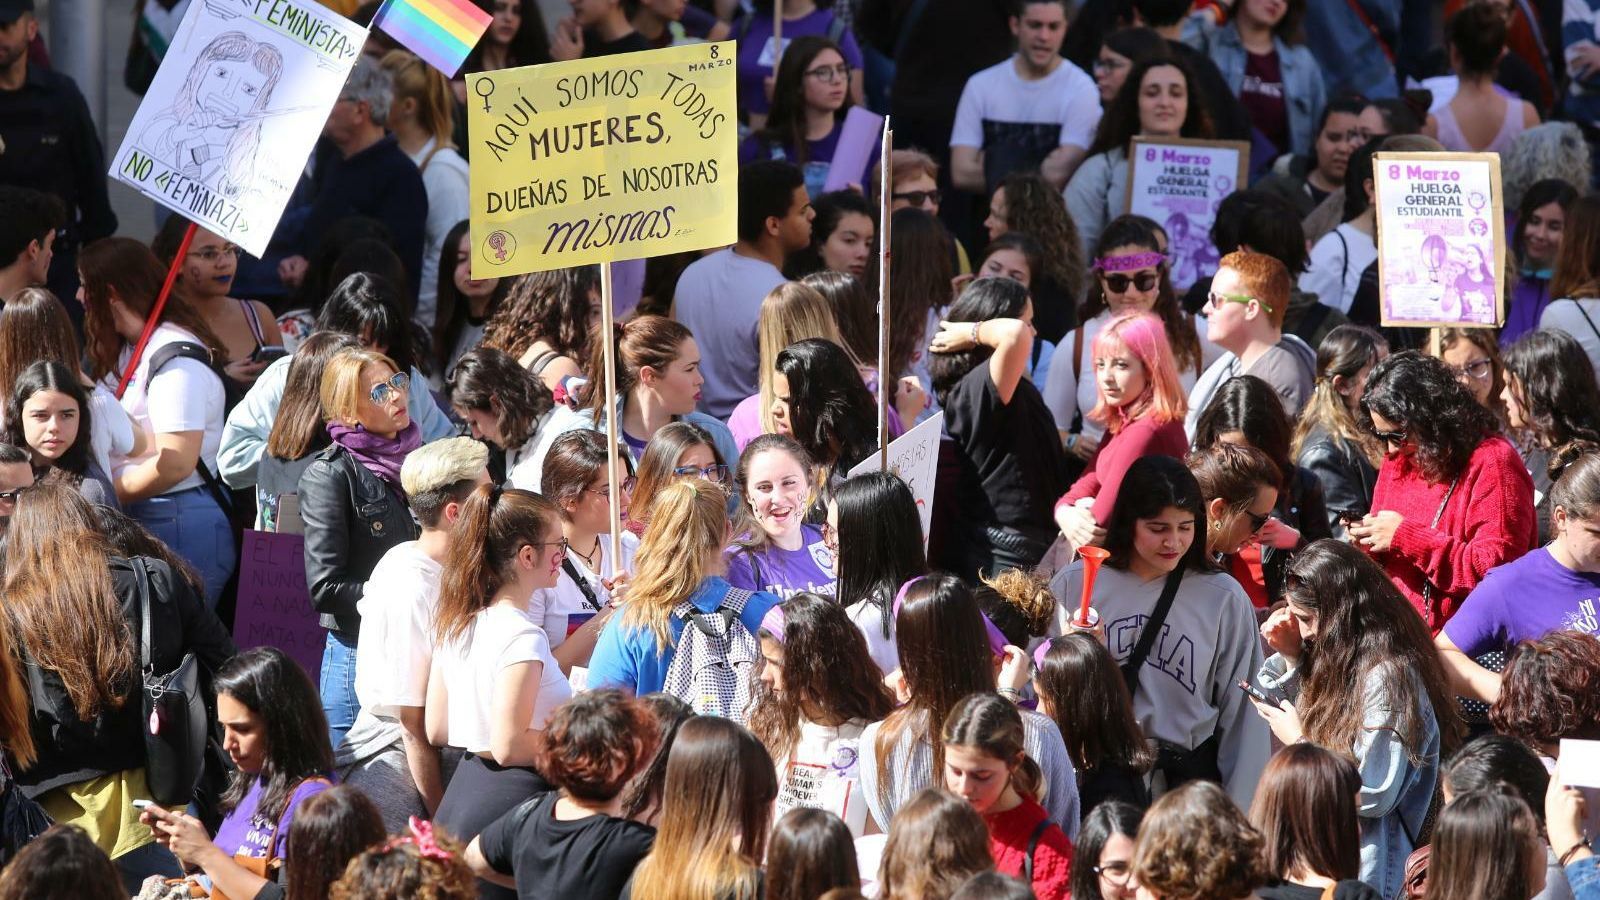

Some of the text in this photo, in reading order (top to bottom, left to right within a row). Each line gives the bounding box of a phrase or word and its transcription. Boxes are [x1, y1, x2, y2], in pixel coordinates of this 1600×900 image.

[710, 45, 719, 59] 8
[689, 58, 732, 72] MARZO
[485, 69, 725, 162] AQUÍ SOMOS TODAS
[529, 111, 671, 160] MUJERES,
[124, 151, 153, 182] NO
[1146, 148, 1211, 165] 8 Marzo
[1389, 165, 1460, 181] 8 Marzo
[486, 158, 718, 214] DUEÑAS DE NOSOTRAS
[1411, 183, 1461, 194] HUELGA
[1405, 195, 1463, 206] GENERAL
[1397, 207, 1464, 217] ESTUDIANTIL
[541, 205, 676, 255] mismas
[253, 538, 280, 566] EL
[1104, 613, 1196, 695] CIA
